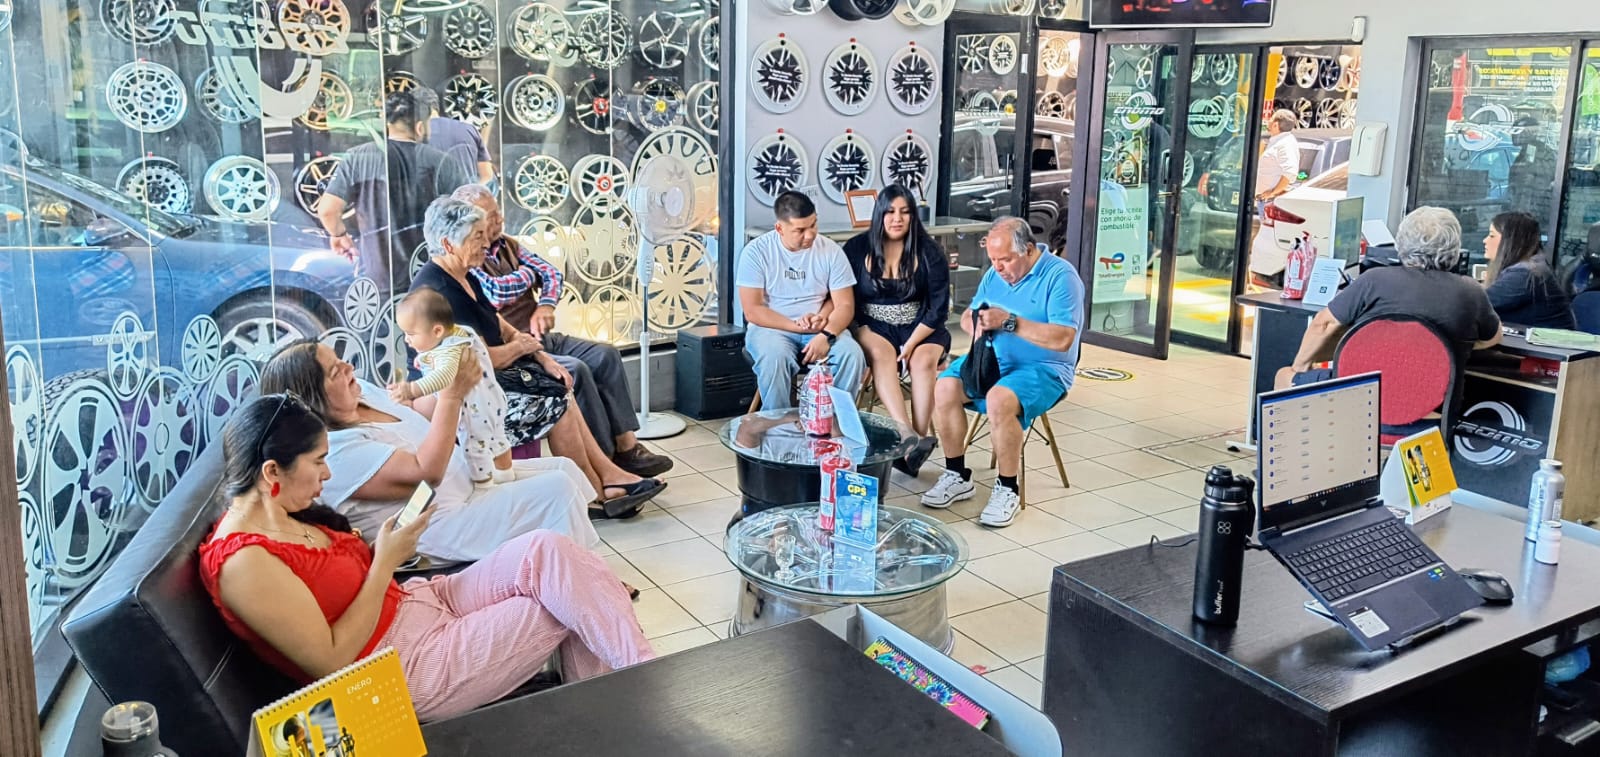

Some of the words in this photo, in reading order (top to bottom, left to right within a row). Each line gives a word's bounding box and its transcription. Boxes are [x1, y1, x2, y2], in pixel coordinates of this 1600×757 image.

[1101, 207, 1116, 215] Elige
[847, 484, 867, 497] GPS
[347, 677, 372, 694] ENERO
